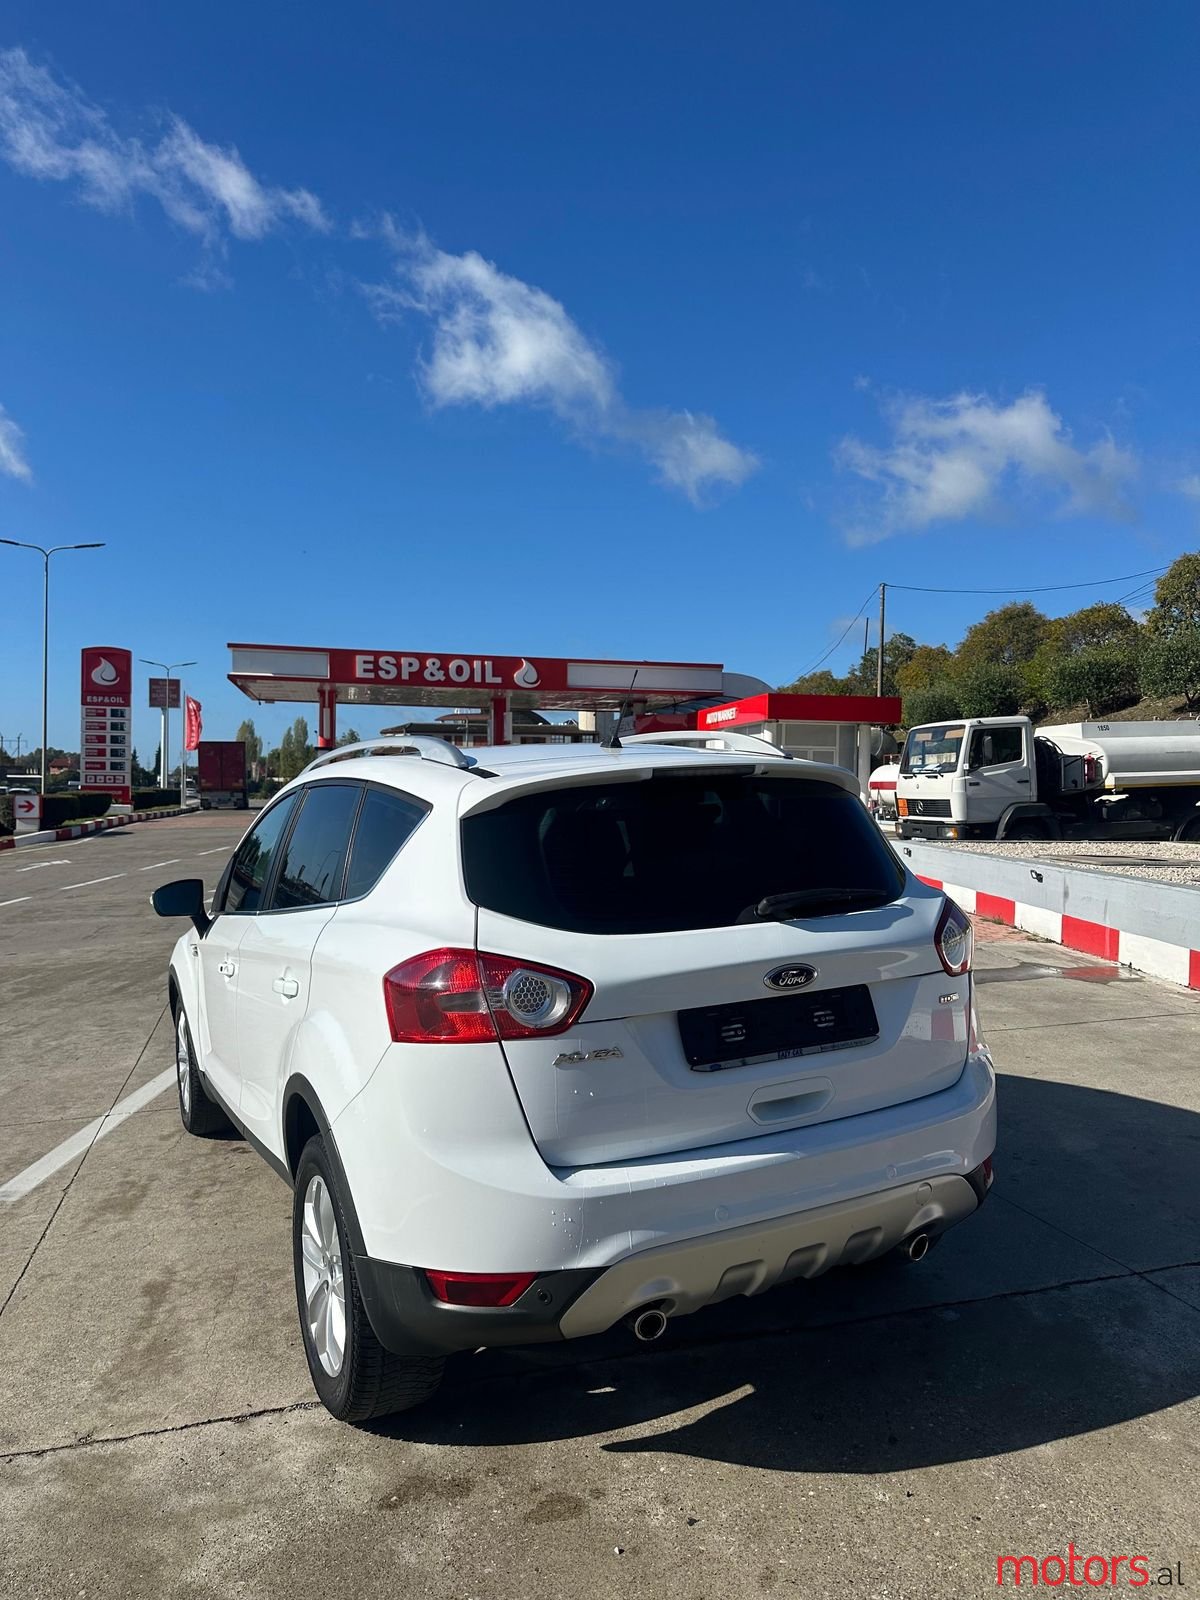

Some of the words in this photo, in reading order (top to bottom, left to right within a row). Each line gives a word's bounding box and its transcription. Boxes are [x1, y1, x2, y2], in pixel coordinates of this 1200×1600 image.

[355, 654, 502, 684] ESP&OIL
[86, 695, 125, 704] ESP&OIL
[779, 970, 807, 986] Ford
